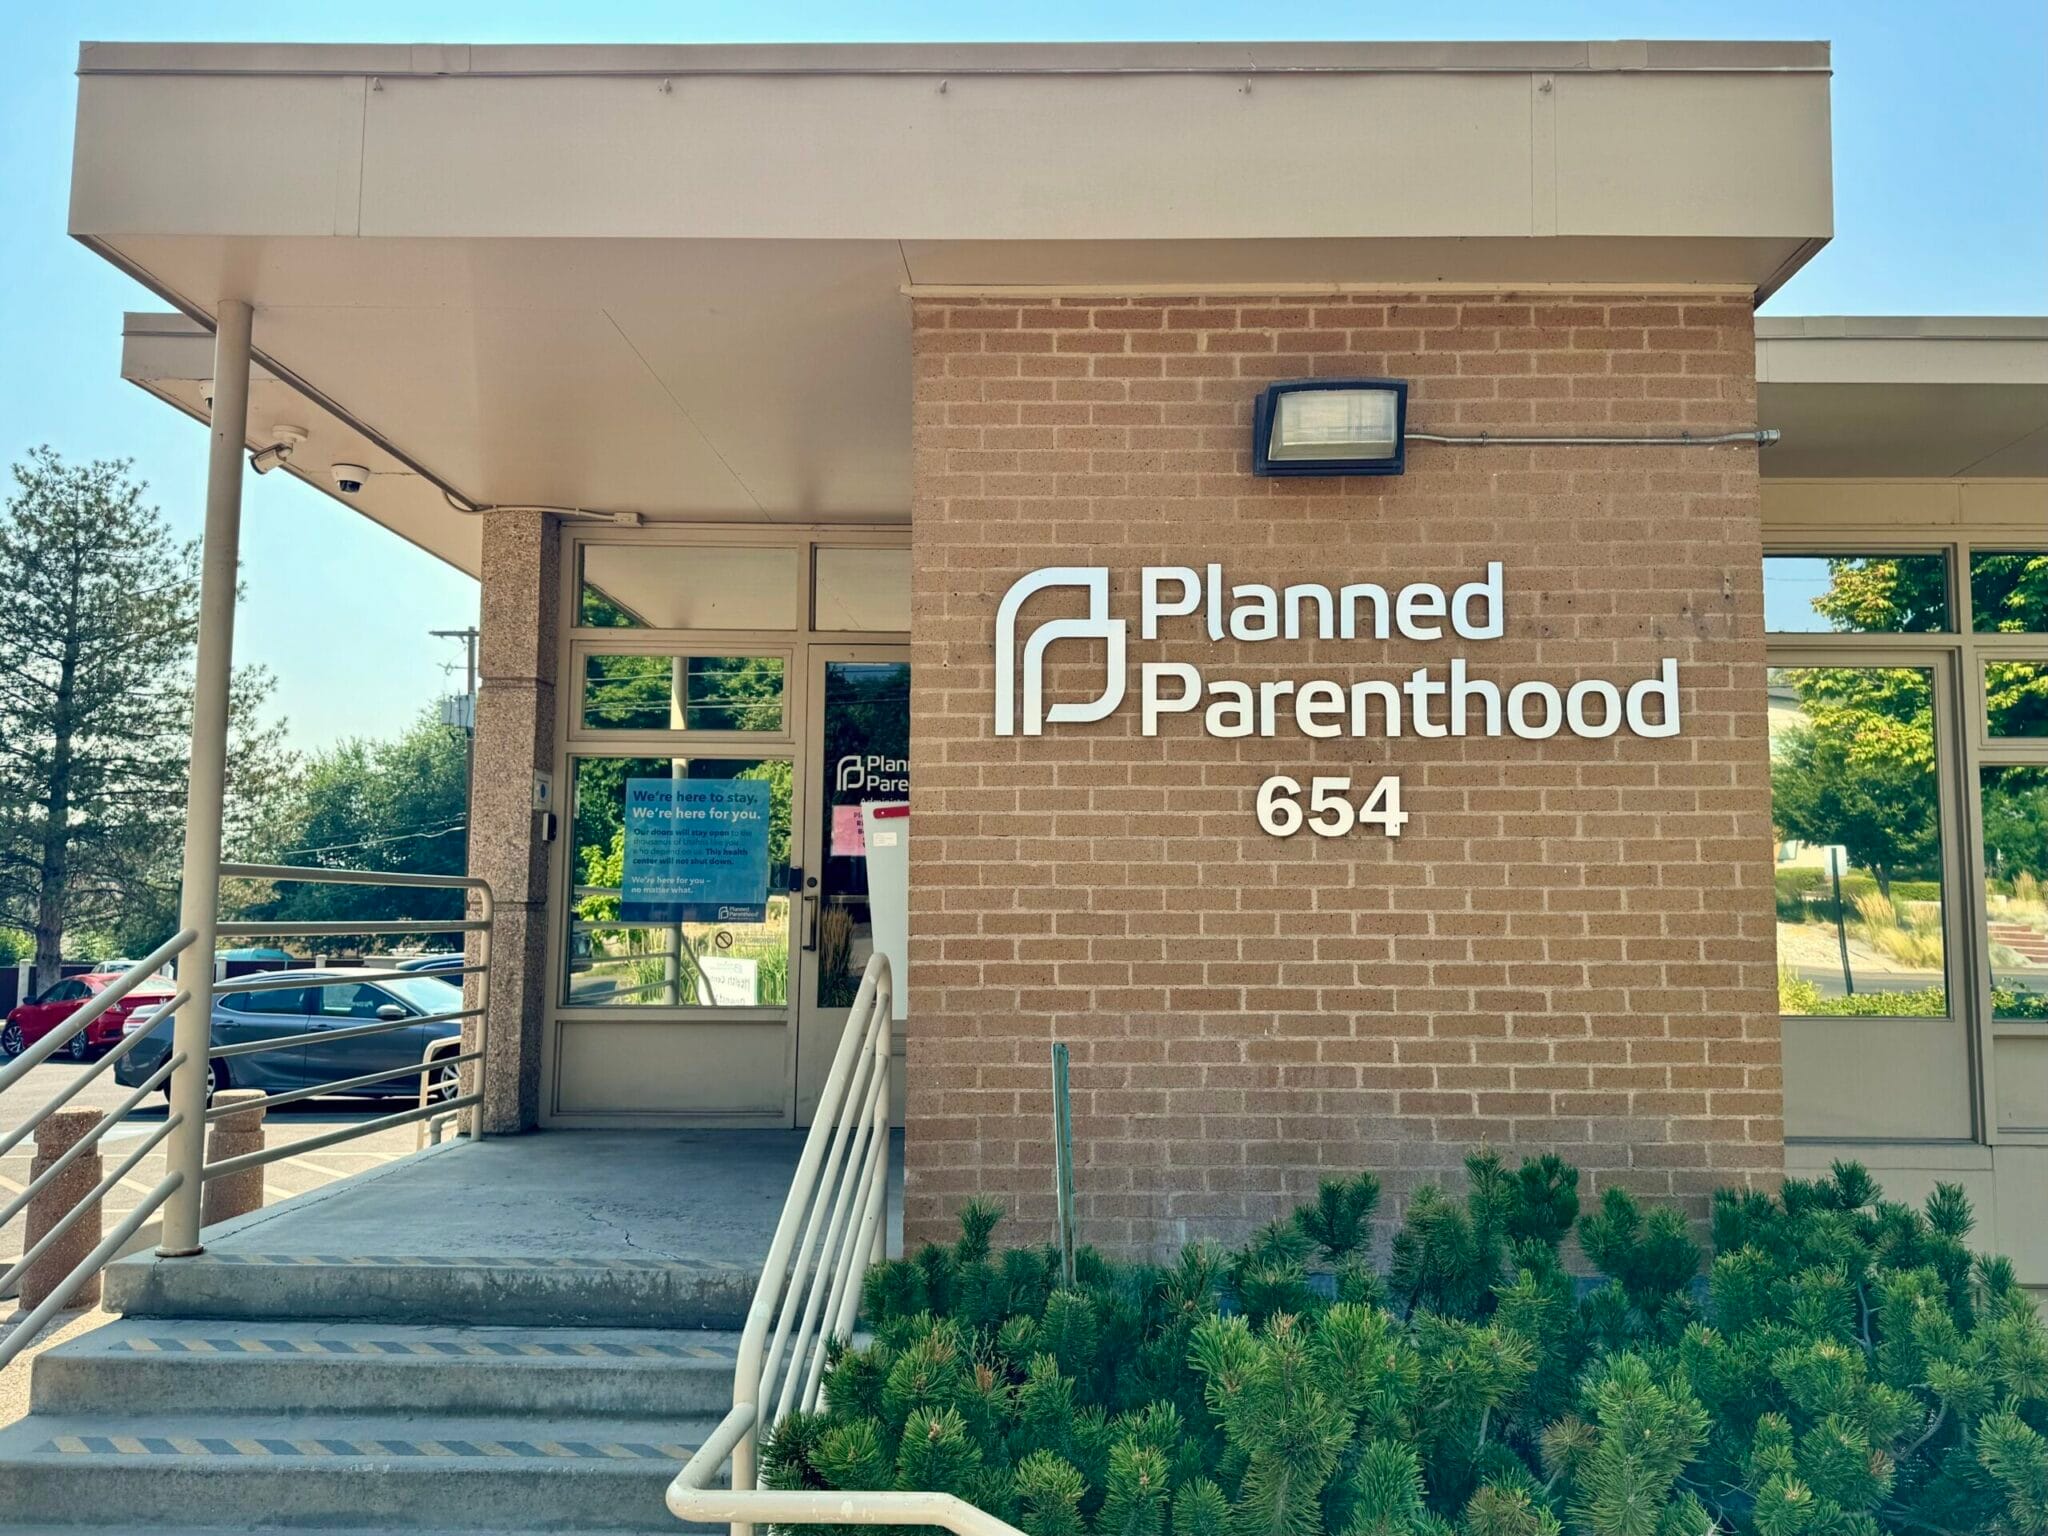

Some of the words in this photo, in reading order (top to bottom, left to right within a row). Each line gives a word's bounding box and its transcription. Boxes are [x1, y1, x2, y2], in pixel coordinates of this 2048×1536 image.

[1142, 562, 1503, 641] Planned
[1142, 658, 1680, 739] Parenthood
[867, 755, 910, 772] Plan
[633, 790, 672, 802] We're
[677, 790, 706, 803] here
[710, 792, 723, 803] to
[727, 792, 758, 806] stay.
[1255, 775, 1409, 837] 654
[632, 807, 672, 819] We're
[676, 807, 706, 819] here
[709, 807, 729, 819] for
[731, 810, 760, 822] you.
[633, 828, 649, 836] Our
[650, 828, 673, 836] doors
[675, 828, 690, 836] will
[691, 829, 707, 838] stay
[709, 830, 729, 838] open
[705, 848, 722, 856] This
[723, 848, 749, 856] health
[632, 857, 657, 865] center
[659, 857, 674, 865] will
[675, 857, 689, 865] not
[690, 857, 708, 865] shut
[709, 857, 734, 866] down.
[631, 876, 655, 884] We're
[656, 876, 675, 884] here
[676, 876, 688, 884] for
[689, 878, 705, 886] you
[670, 886, 693, 894] what.
